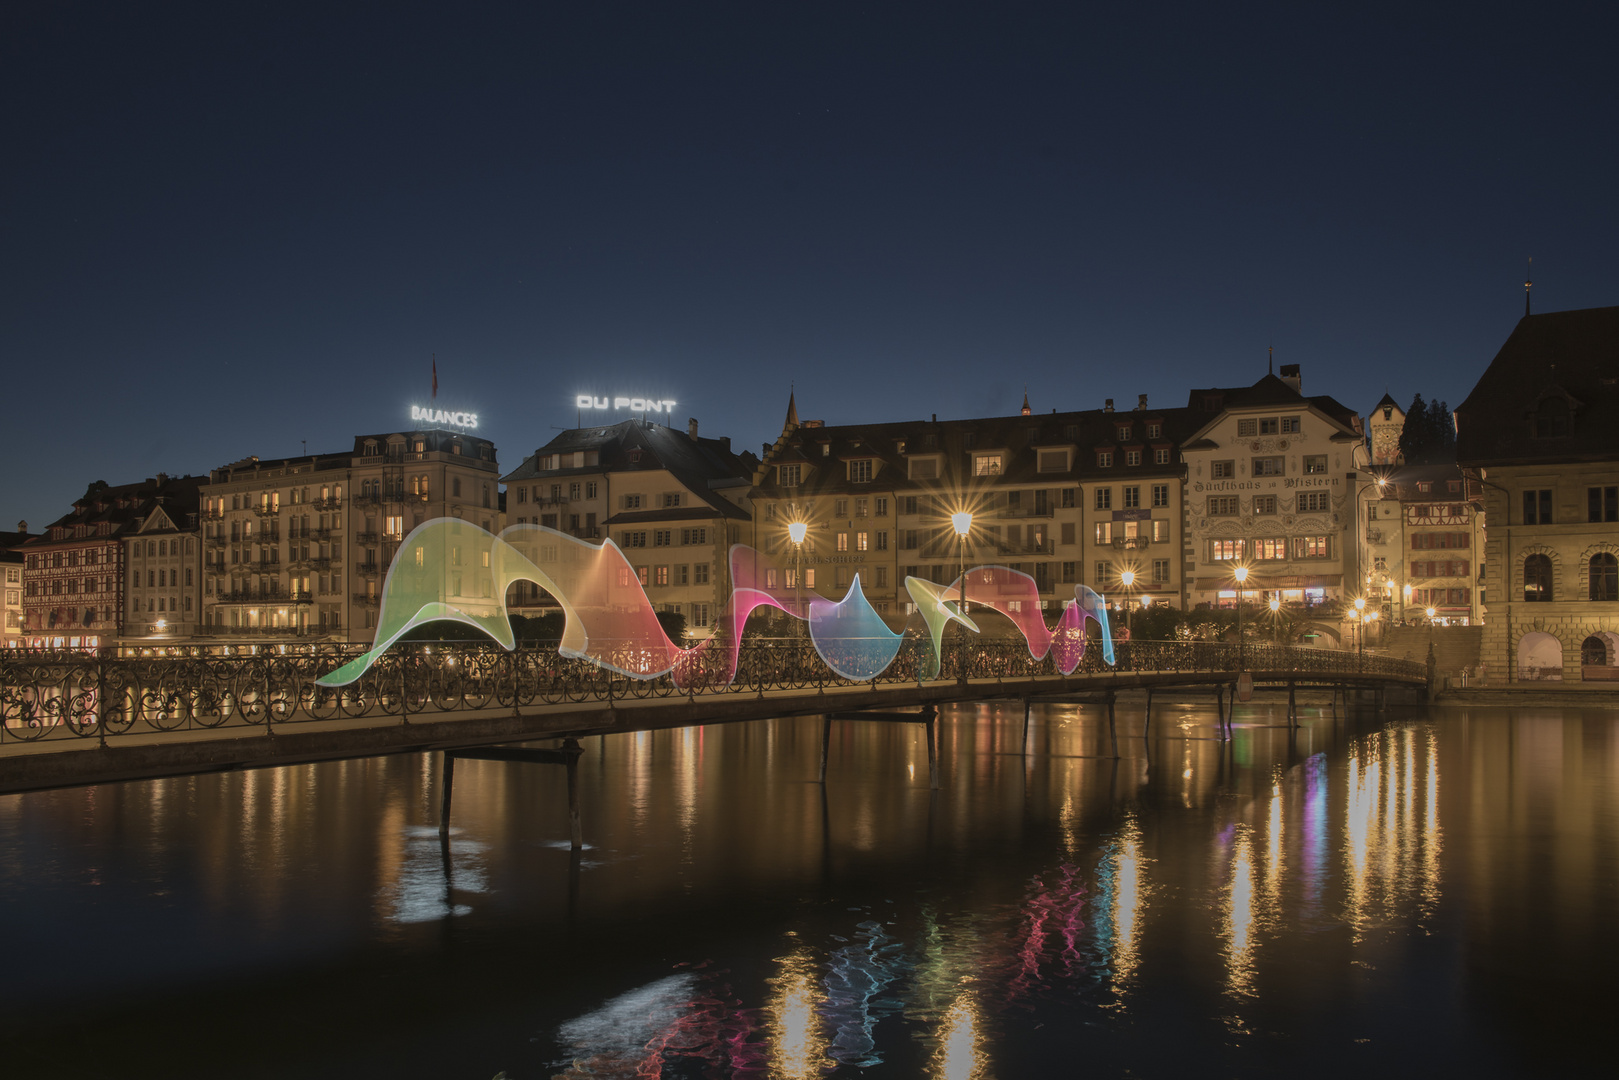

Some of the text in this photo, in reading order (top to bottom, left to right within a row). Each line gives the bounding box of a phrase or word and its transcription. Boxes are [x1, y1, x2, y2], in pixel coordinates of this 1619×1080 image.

[577, 395, 677, 413] DU PONT
[411, 405, 478, 428] BALANCES
[1283, 477, 1339, 489] Pfistern
[825, 555, 864, 564] SCHIFF
